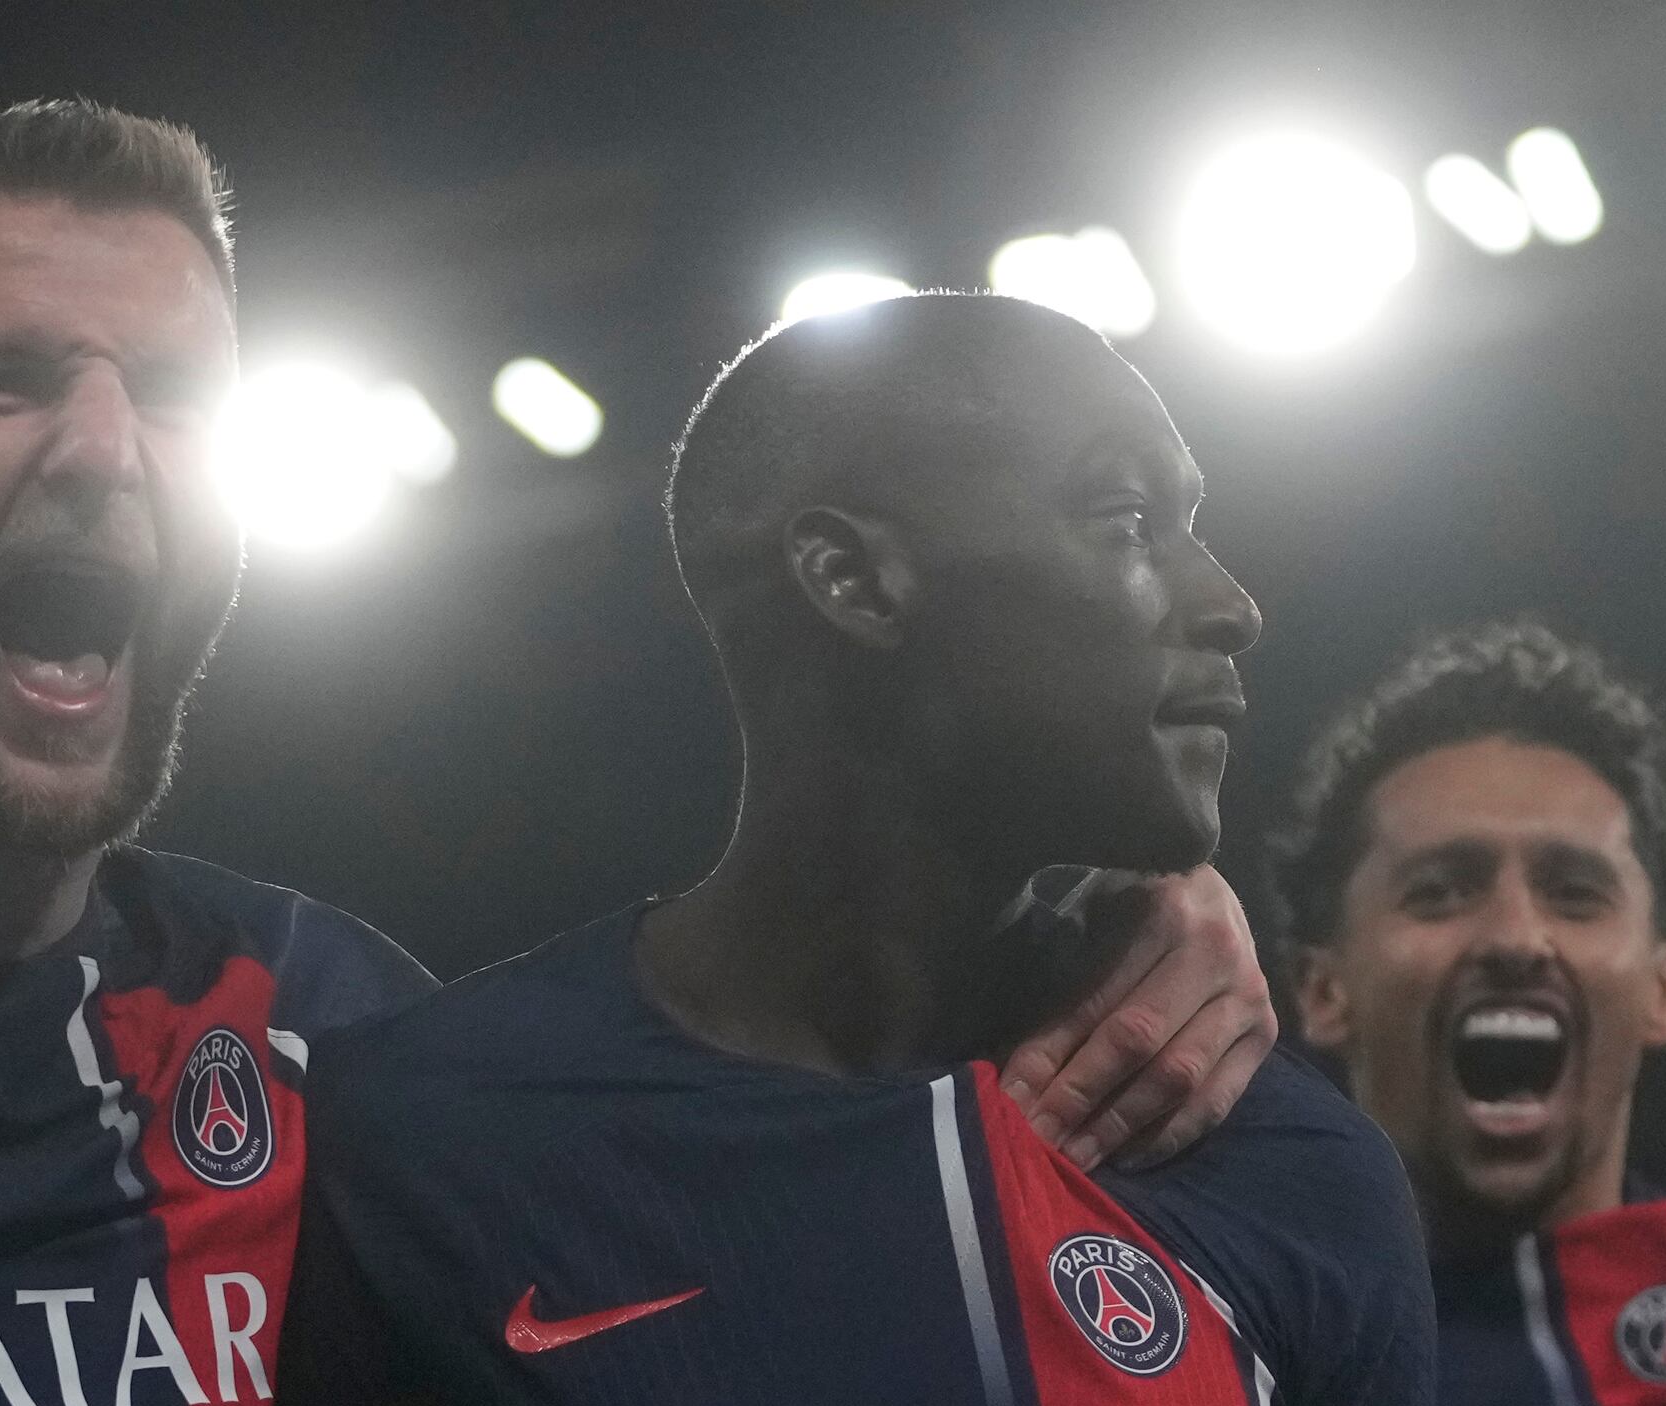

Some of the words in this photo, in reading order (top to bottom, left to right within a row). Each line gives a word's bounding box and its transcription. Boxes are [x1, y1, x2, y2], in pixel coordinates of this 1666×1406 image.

[188, 1037, 243, 1080] PARIS
[194, 1150, 222, 1172] SAINT
[231, 1137, 261, 1172] GERMAIN
[1058, 1243, 1135, 1278] PARIS
[1135, 1331, 1170, 1362] GERMAIN
